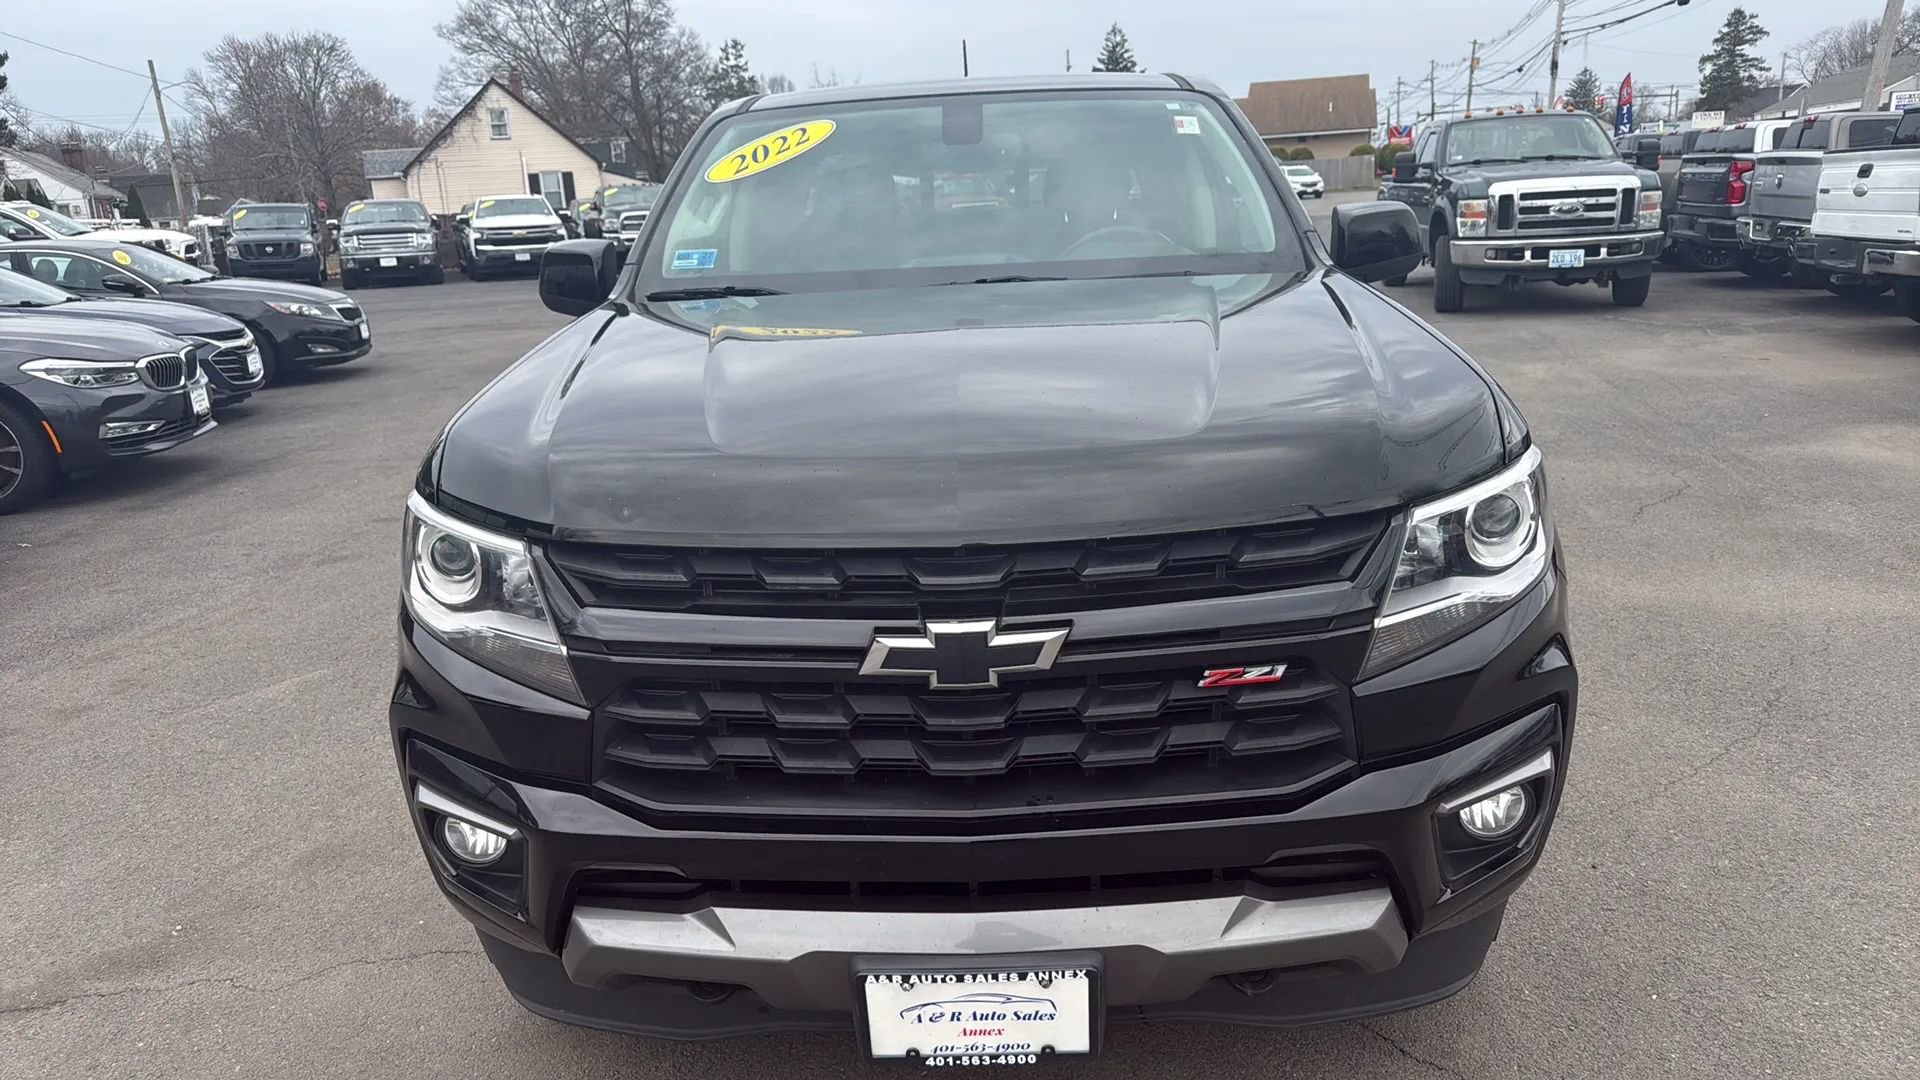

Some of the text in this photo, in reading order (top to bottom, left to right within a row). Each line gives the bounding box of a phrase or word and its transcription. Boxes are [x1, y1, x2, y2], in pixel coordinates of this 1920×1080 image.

[731, 127, 810, 175] 2022
[866, 969, 1087, 984] A&R AUTO SALES ANNEX
[911, 1010, 1056, 1024] A & R Auto Sales
[957, 1027, 1005, 1037] Annex
[931, 1041, 1031, 1055] 401-563-4900
[925, 1054, 1037, 1067] 401-563-4900
